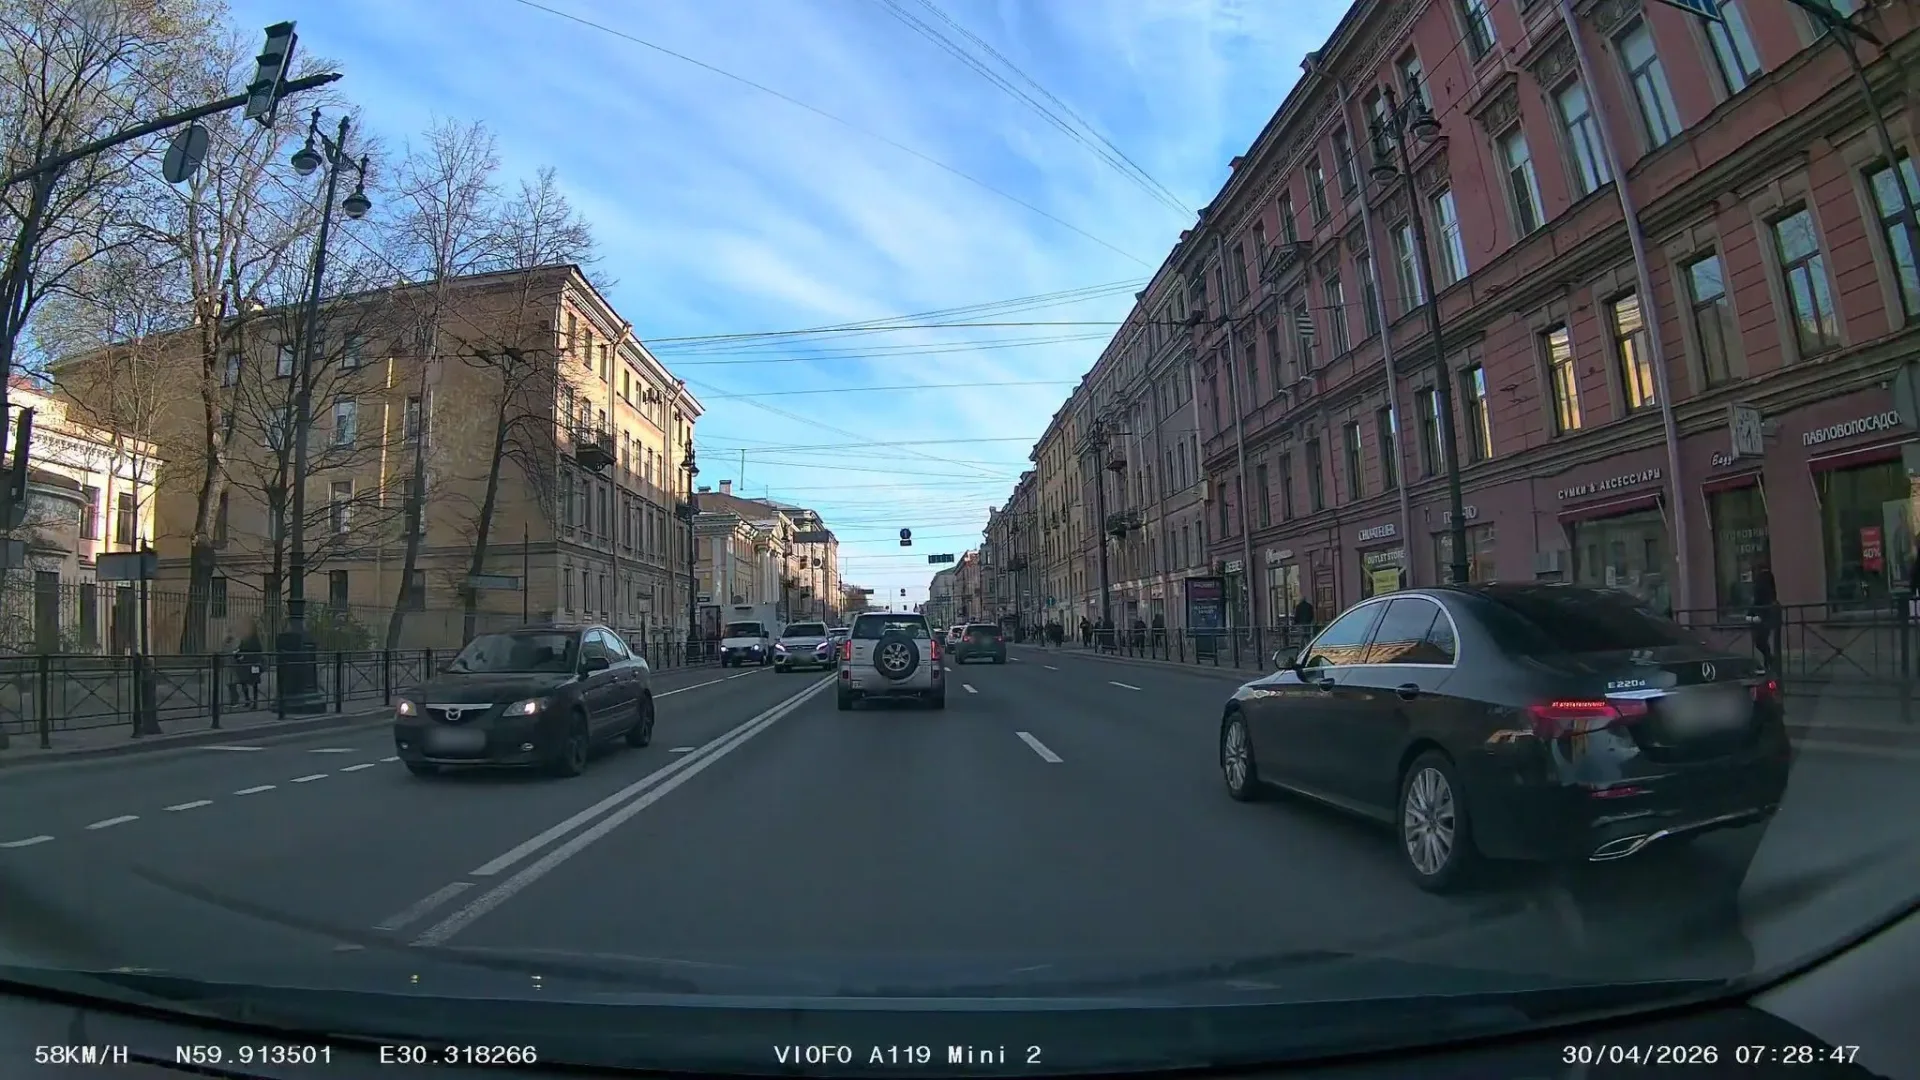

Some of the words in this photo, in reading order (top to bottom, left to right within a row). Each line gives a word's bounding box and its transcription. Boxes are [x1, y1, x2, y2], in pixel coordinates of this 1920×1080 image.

[1558, 485, 1587, 499] СУМКИ
[1600, 468, 1662, 491] АКСЕССУАРЫ
[1863, 547, 1881, 559] 40%
